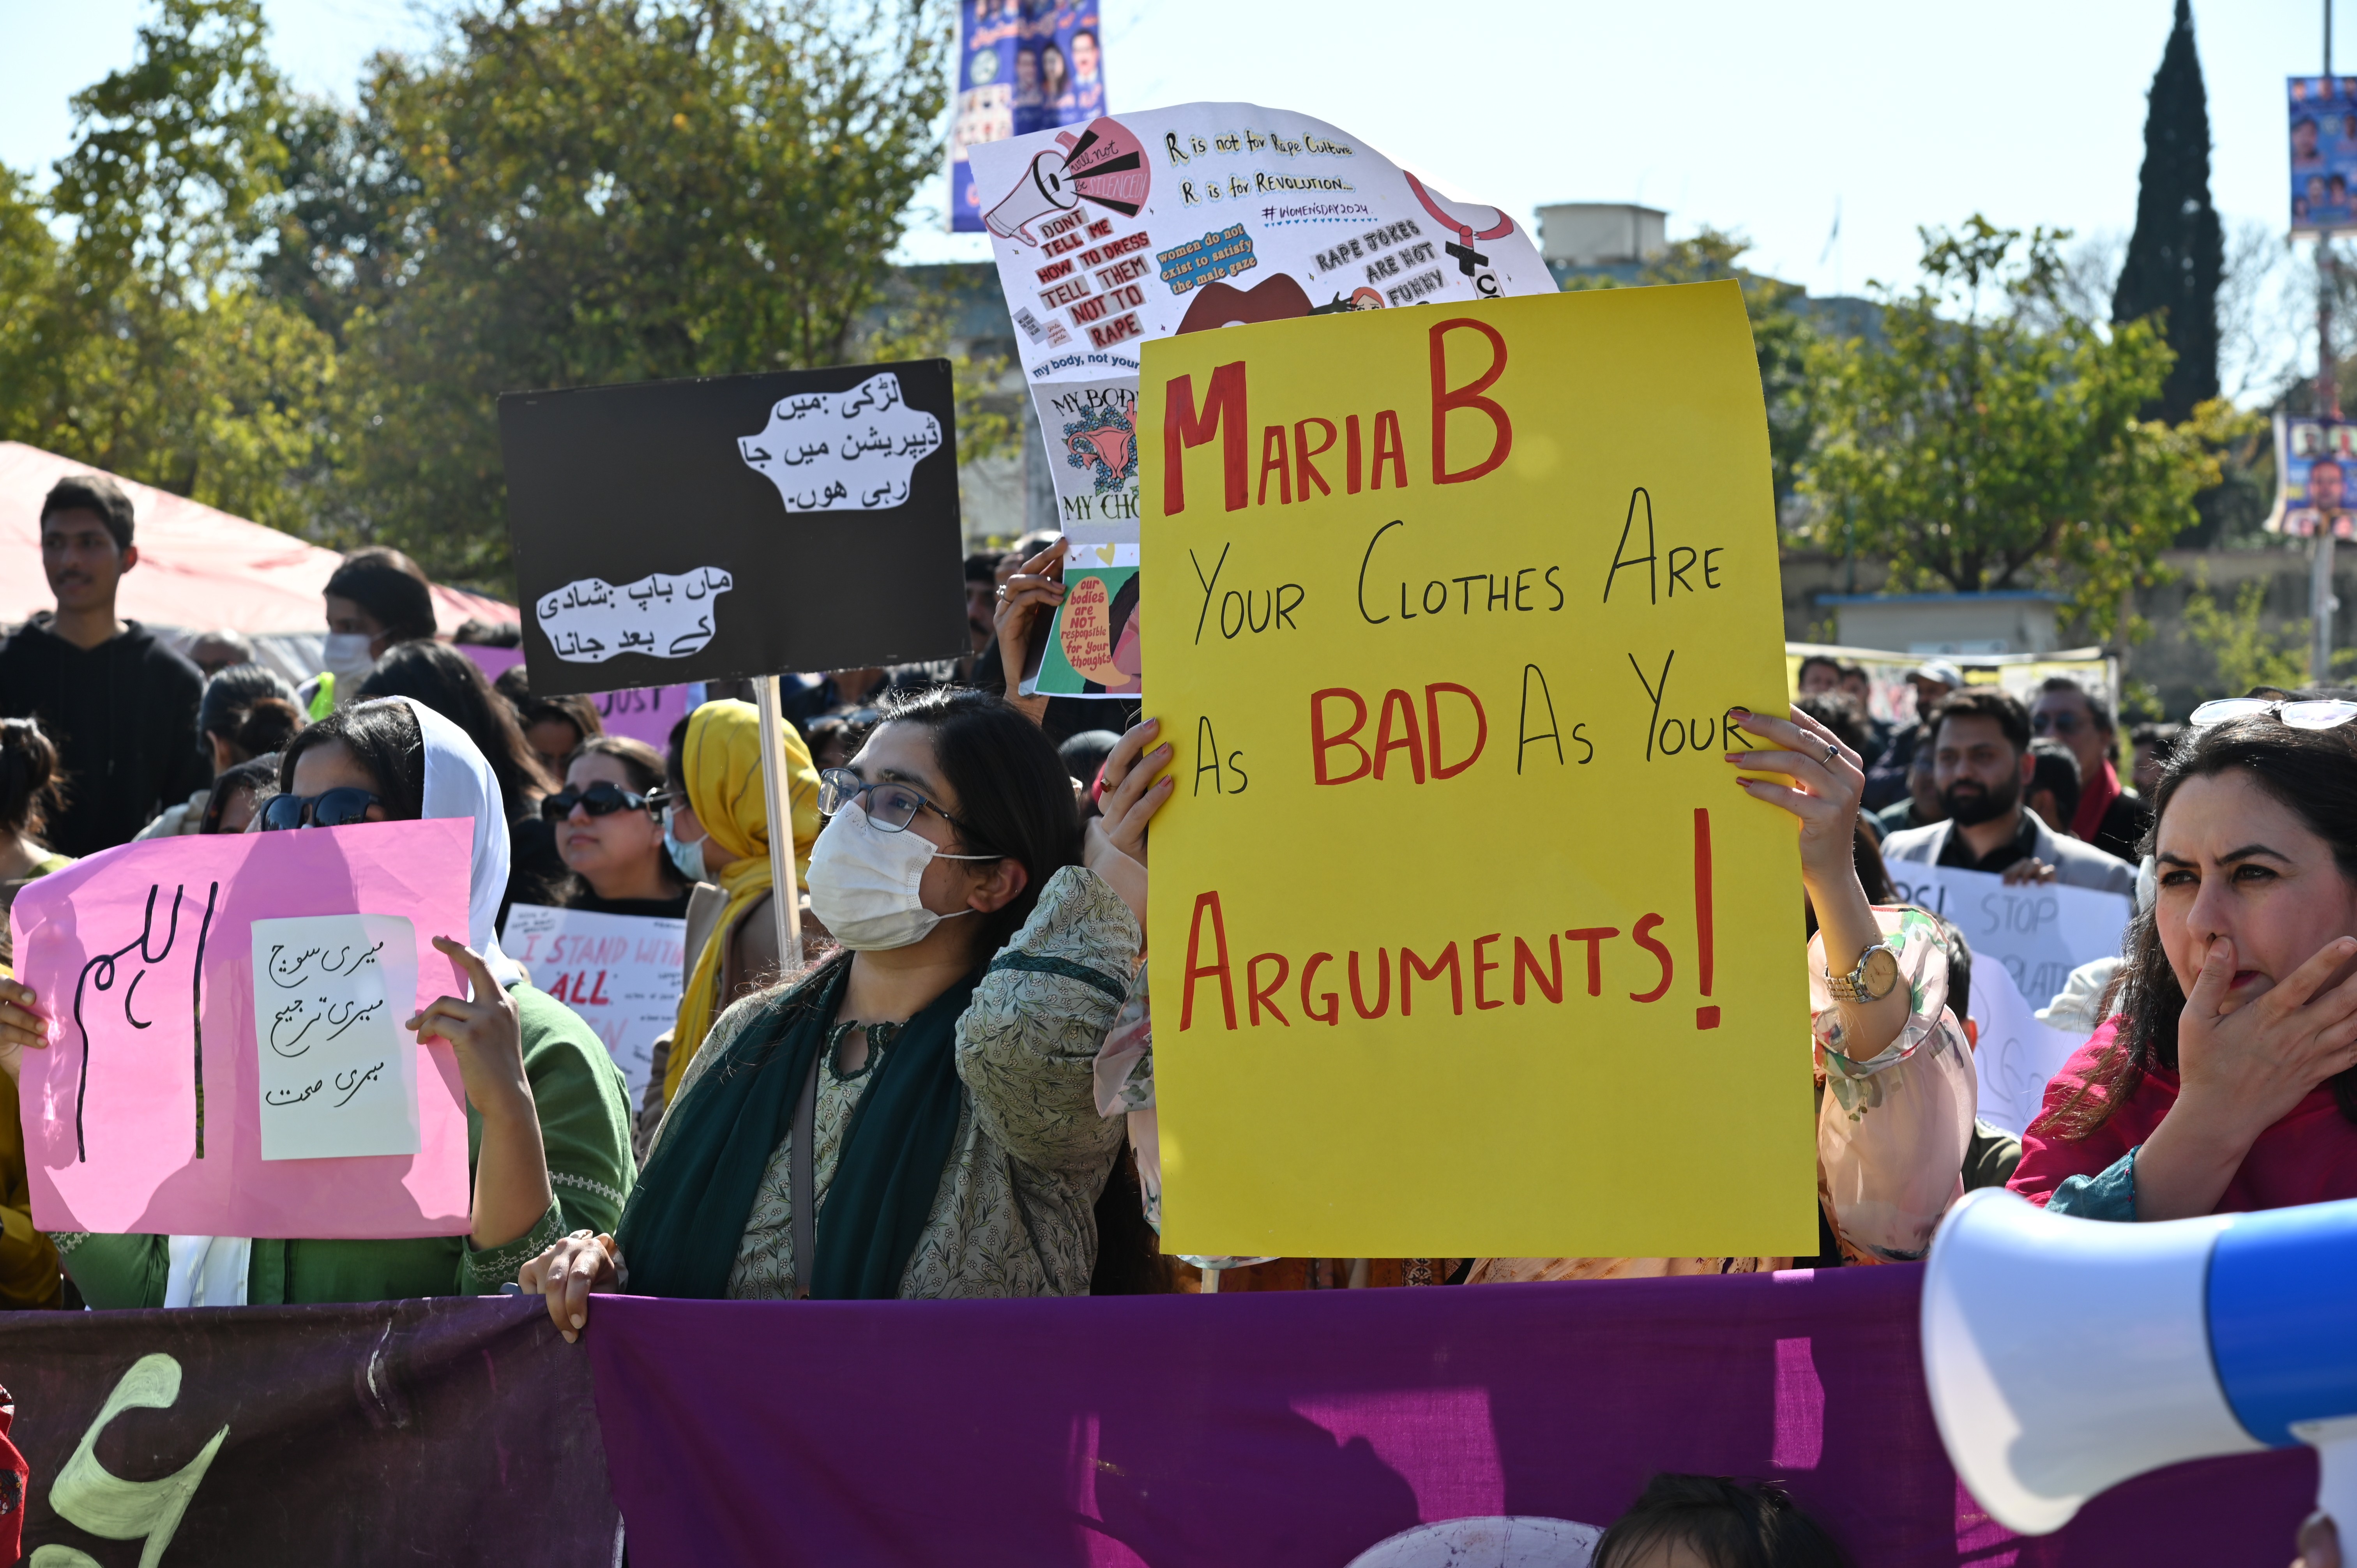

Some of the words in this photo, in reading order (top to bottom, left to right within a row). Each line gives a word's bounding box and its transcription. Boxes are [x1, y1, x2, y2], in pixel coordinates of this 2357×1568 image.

[1071, 152, 1094, 171] will
[1092, 140, 1119, 161] not
[1166, 132, 1189, 162] R
[1191, 136, 1206, 154] is
[1216, 134, 1240, 152] not
[1247, 130, 1265, 152] for
[1271, 134, 1301, 156] Rape
[1306, 136, 1353, 155] Culture
[1074, 180, 1087, 191] be
[1088, 173, 1147, 201] SILENCED!
[1183, 182, 1198, 203] R
[1208, 185, 1220, 198] is
[1230, 177, 1249, 198] for
[1041, 233, 1084, 257] TELL
[1088, 219, 1111, 238] ME
[1042, 210, 1082, 238] DONT
[1037, 259, 1071, 283] HOW
[1080, 250, 1101, 266] TO
[1103, 233, 1149, 259] DRESS
[1158, 241, 1202, 264] women
[1205, 234, 1220, 246] do
[1223, 224, 1244, 240] not
[1162, 260, 1193, 281] exist
[1195, 256, 1209, 268] to
[1212, 239, 1252, 262] satisfy
[1316, 238, 1364, 272] RAPE
[1363, 220, 1421, 251] JOKES
[1172, 279, 1193, 294] the
[1196, 267, 1226, 285] male
[1229, 256, 1256, 276] gaze
[1366, 255, 1399, 284] ARE
[1399, 240, 1435, 268] NOT
[1041, 281, 1090, 308] TELL
[1096, 257, 1147, 288] THEM
[1386, 269, 1444, 307] FUNNY
[1071, 295, 1107, 325] NOT
[1111, 285, 1142, 309] TO
[1091, 314, 1140, 347] RAPE
[1033, 364, 1050, 378] my
[1050, 355, 1084, 369] body,
[1088, 353, 1108, 363] not
[841, 376, 899, 418] لڑکی
[1051, 391, 1081, 417] MY
[1085, 388, 1138, 409] BOD
[1164, 361, 1408, 517] MARIA
[1429, 318, 1512, 485] B
[742, 440, 772, 470] جا
[784, 441, 829, 466] میں
[862, 480, 908, 508] رہی
[1063, 495, 1093, 520] MY
[628, 574, 673, 612] باپ
[686, 567, 731, 600] ماں
[1071, 591, 1104, 605] bodies
[1081, 580, 1099, 590] our
[1070, 616, 1096, 629] NOT
[1075, 606, 1093, 616] are
[555, 631, 605, 659] جانا
[618, 630, 655, 652] بعد
[669, 614, 712, 655] کے
[1061, 626, 1106, 642] responsible
[1066, 640, 1082, 654] for
[1071, 652, 1111, 671] thoughts
[1311, 682, 1488, 786] BAD
[1981, 892, 2059, 936] STOP
[322, 941, 384, 977] میری
[519, 934, 541, 961] I
[546, 934, 628, 965] STAND
[269, 944, 320, 989] سوچ
[548, 969, 609, 1005] ALL
[270, 997, 327, 1058] ترجیح
[327, 999, 383, 1041] میری
[266, 1079, 323, 1105] صحت
[334, 1062, 384, 1108] میری
